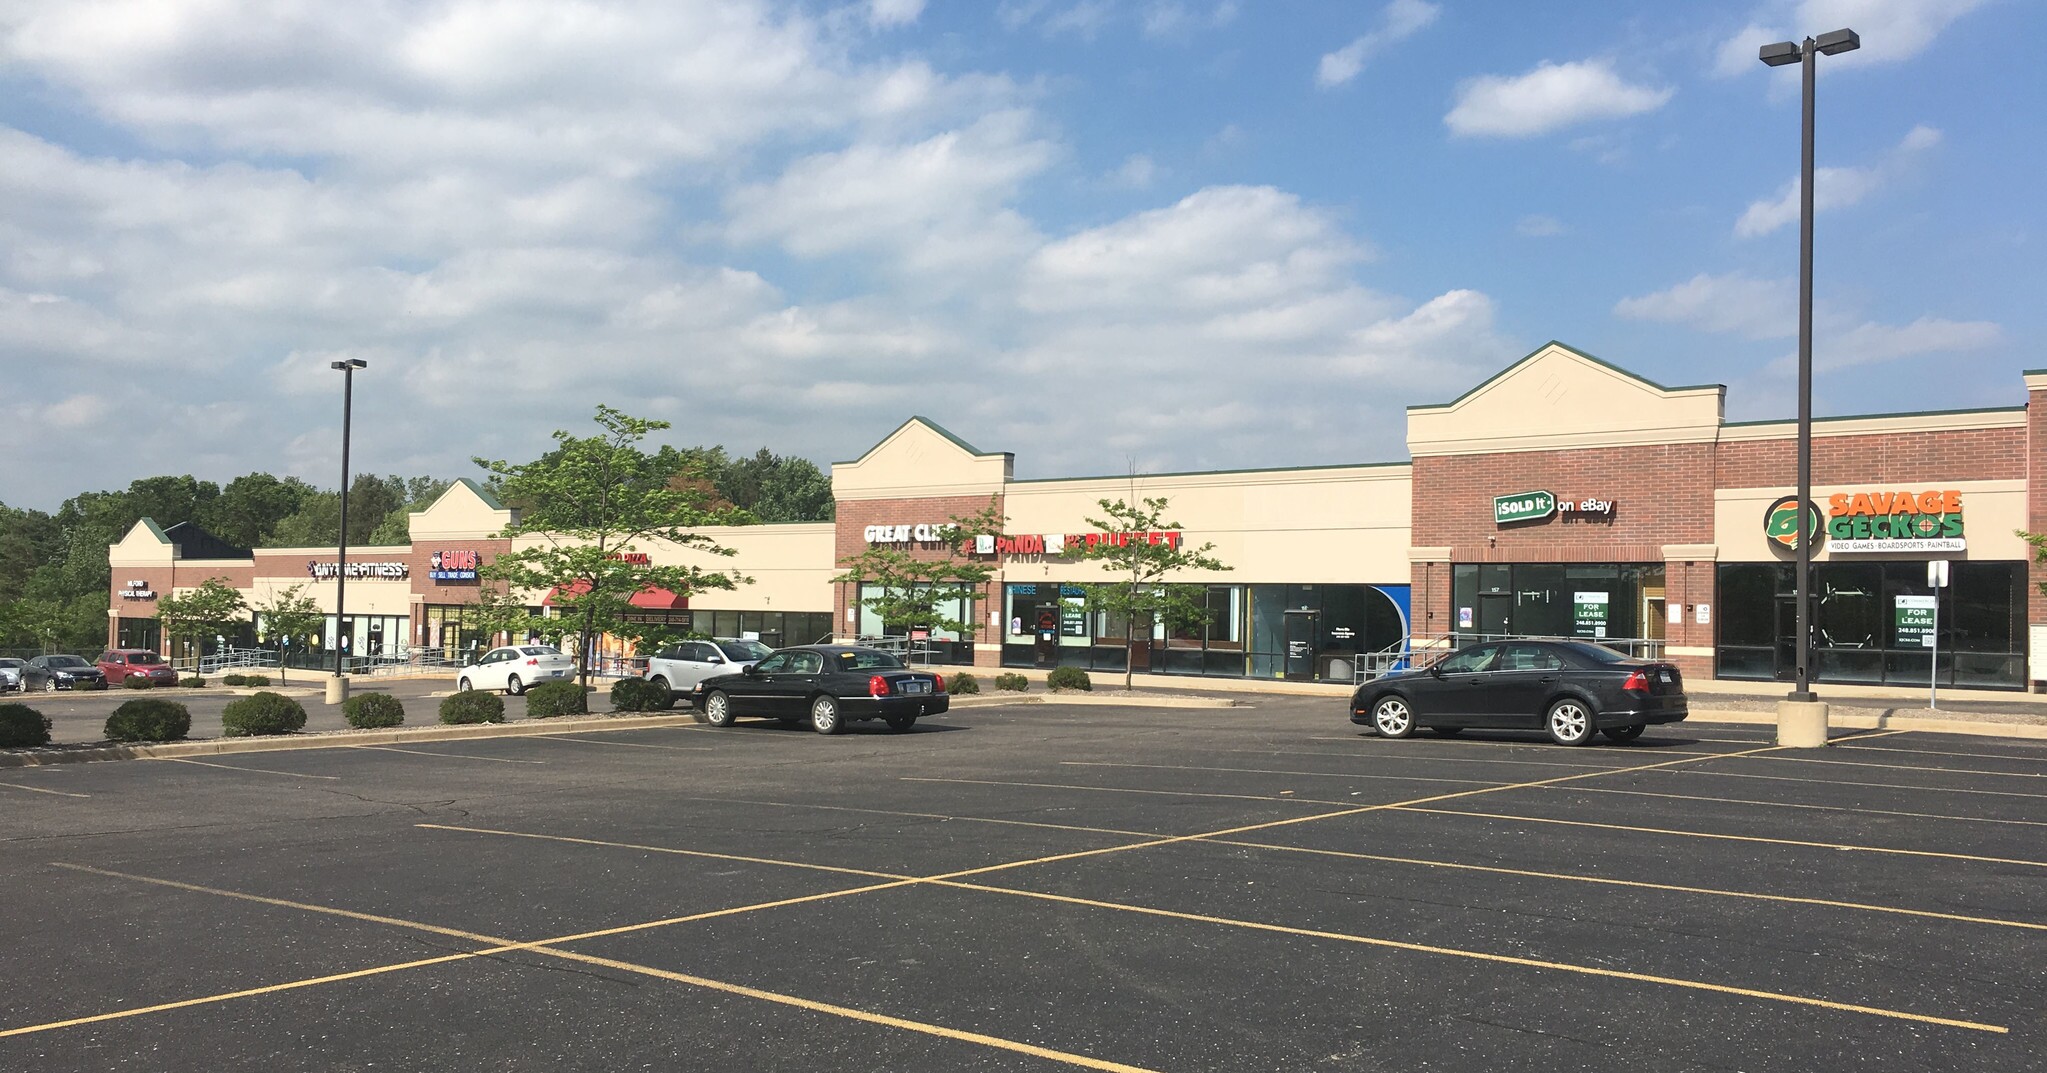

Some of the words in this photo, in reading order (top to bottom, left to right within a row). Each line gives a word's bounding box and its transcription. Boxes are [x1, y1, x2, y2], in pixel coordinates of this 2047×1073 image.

[1497, 500, 1534, 515] iSOLD
[1557, 500, 1575, 512] on
[1580, 498, 1613, 515] eBay
[1829, 490, 1962, 516] SAVAGE
[864, 525, 911, 542] GREAT
[914, 523, 957, 541] CLI
[1828, 514, 1964, 539] GECKOS
[996, 535, 1044, 554] PANDA
[1852, 542, 1875, 550] GAMES
[1877, 541, 1924, 549] BOARDSPORTS
[1927, 540, 1961, 549] PAINTBALL
[441, 550, 476, 570] GUNS
[624, 553, 648, 565] PIZZA
[314, 562, 358, 576] ANYTME
[360, 562, 403, 576] FITNESS
[1583, 603, 1600, 611] FOR
[1901, 617, 1933, 625] LEASE
